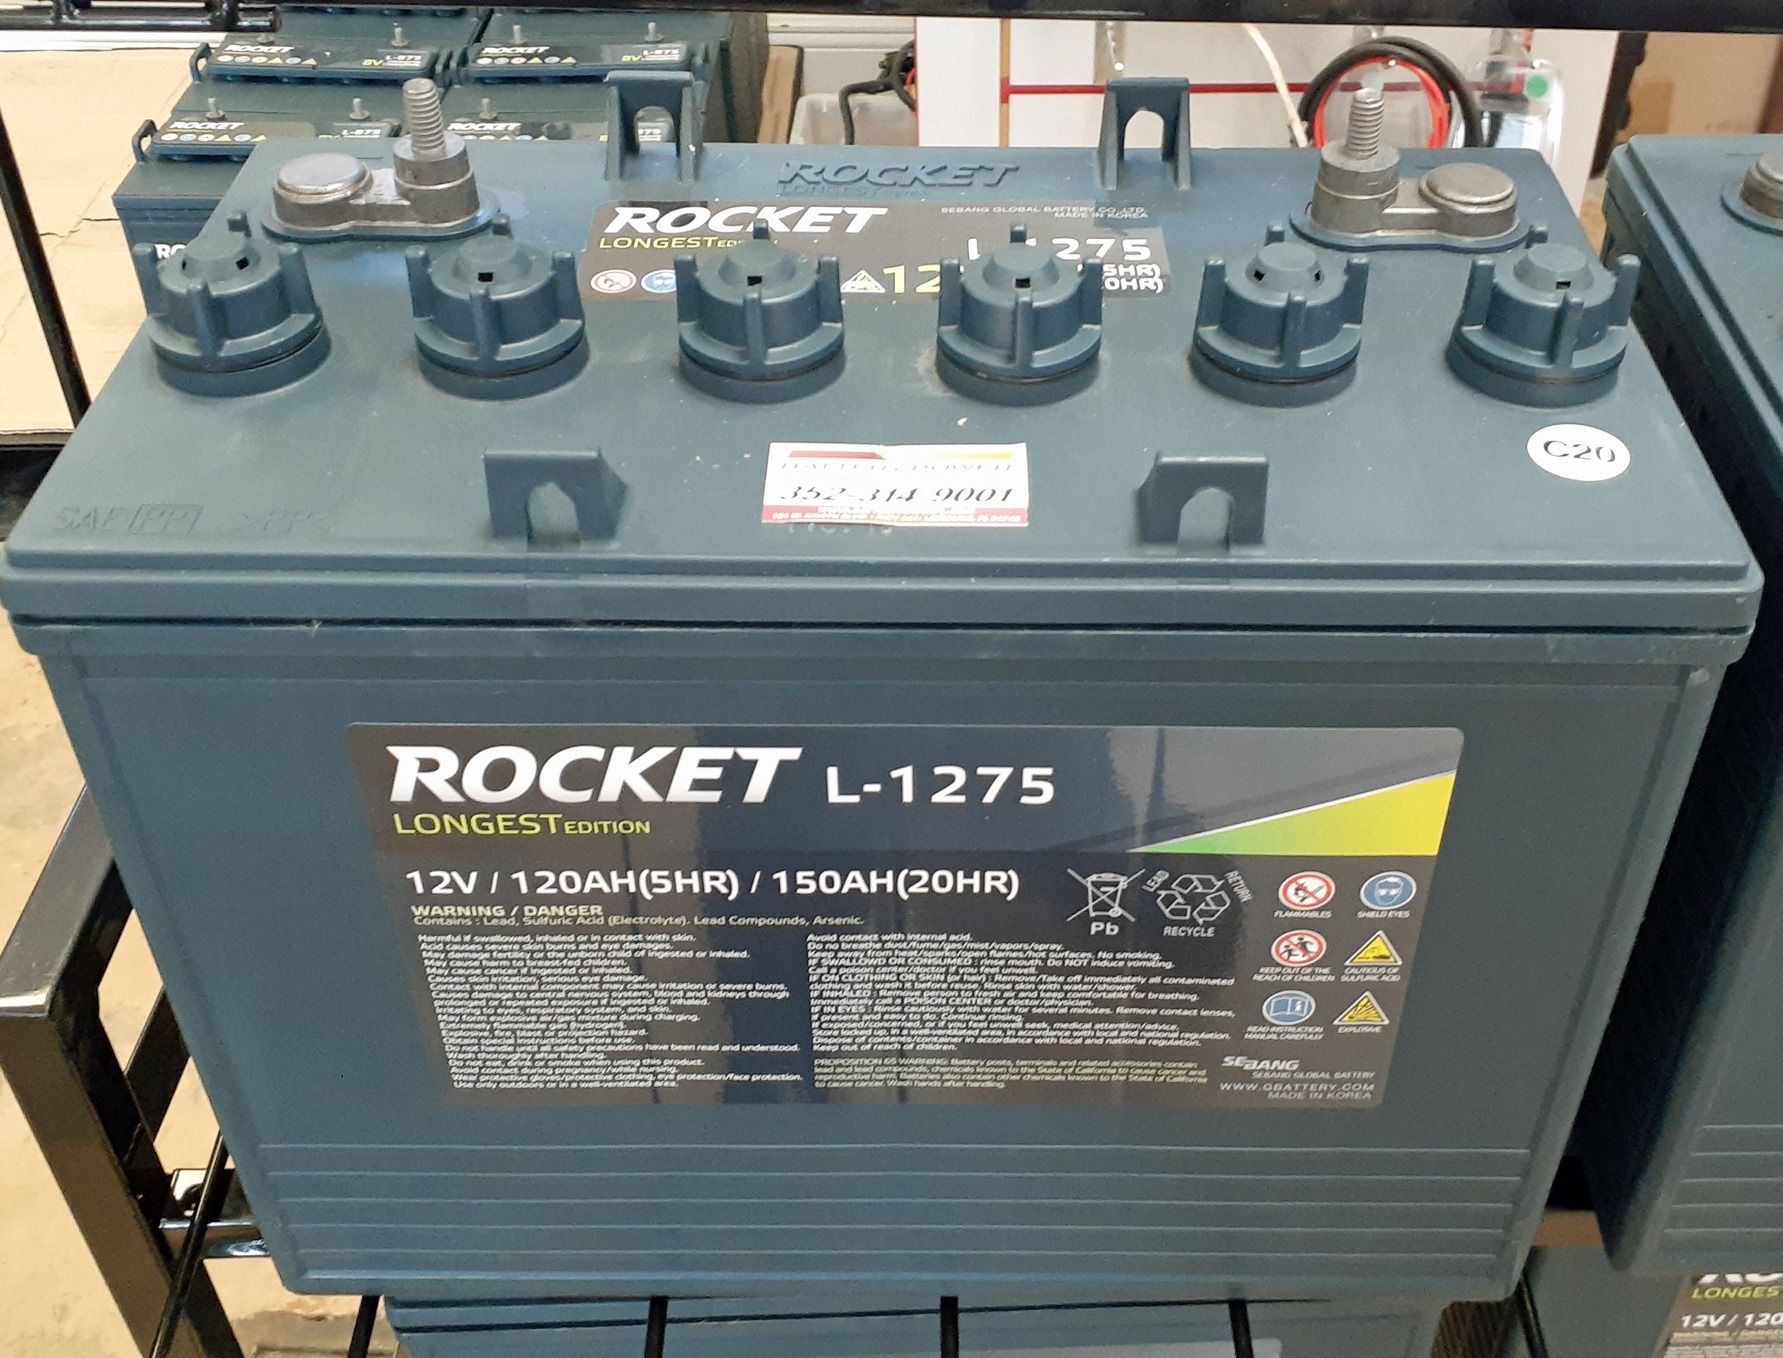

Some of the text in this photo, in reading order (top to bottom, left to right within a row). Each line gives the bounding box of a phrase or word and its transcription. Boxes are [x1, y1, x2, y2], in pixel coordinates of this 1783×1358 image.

[170, 122, 244, 130] ROCKET
[778, 162, 1020, 188] ROCKET
[603, 206, 889, 234] ROCKET
[599, 237, 718, 249] LONGEST
[1543, 440, 1616, 463] C20
[386, 745, 1055, 806] ROCKET L-1275
[393, 813, 651, 835] LONGEST EDITION
[406, 868, 1020, 900] 12V / 120AH(5HR) / 150AH(20HR)
[1224, 870, 1254, 902] RETURN
[411, 905, 505, 916] WARNING
[523, 905, 603, 916] DANGER
[1274, 910, 1332, 919] FLAMMABLES
[1357, 910, 1410, 919] SHIELD EYES
[414, 916, 472, 926] Contains
[483, 916, 519, 927] Lead,
[522, 916, 573, 926] Sulfuric
[575, 915, 604, 925] Acid
[694, 915, 726, 925] Lead
[729, 915, 810, 927] Compounds,
[812, 915, 865, 925] Arsenic.
[1090, 922, 1120, 936] Pb
[1163, 926, 1216, 937] RECYCLE
[418, 934, 462, 942] Harmful
[472, 935, 534, 943] swallowed,
[536, 934, 575, 942] inhaled
[603, 934, 644, 942] contact
[807, 933, 838, 941] Avoid
[880, 933, 905, 941] with
[906, 933, 947, 941] internal
[949, 933, 973, 941] acid.
[807, 942, 824, 950] Do
[841, 942, 883, 950] breathe
[1253, 974, 1280, 982] REACH
[1341, 974, 1379, 982] SULFURIC
[498, 982, 539, 990] internal
[810, 990, 821, 998] IF
[822, 990, 872, 998] INHALED
[879, 990, 921, 998] Remove
[923, 991, 959, 999] person
[974, 990, 1001, 998] fresh
[1002, 990, 1016, 998] air
[1040, 991, 1065, 999] keep
[1066, 991, 1129, 999] comfortable
[1130, 991, 1145, 999] for
[1147, 992, 1200, 1002] breathing.
[1270, 1026, 1324, 1034] INSTRUCTION
[1338, 1026, 1383, 1034] EXPLOSIVE
[1244, 1033, 1278, 1041] MANUAL
[813, 1044, 839, 1052] Keep
[860, 1043, 872, 1051] of
[873, 1043, 901, 1051] reach
[902, 1043, 915, 1051] of
[916, 1043, 958, 1051] children.
[1221, 1056, 1300, 1071] SEBANG
[1252, 1071, 1377, 1079] SEBANG GLOBAL BATTERY
[475, 1081, 498, 1090] only
[1267, 1091, 1373, 1100] MADE IN KOREA
[1681, 1314, 1727, 1328] 12V
